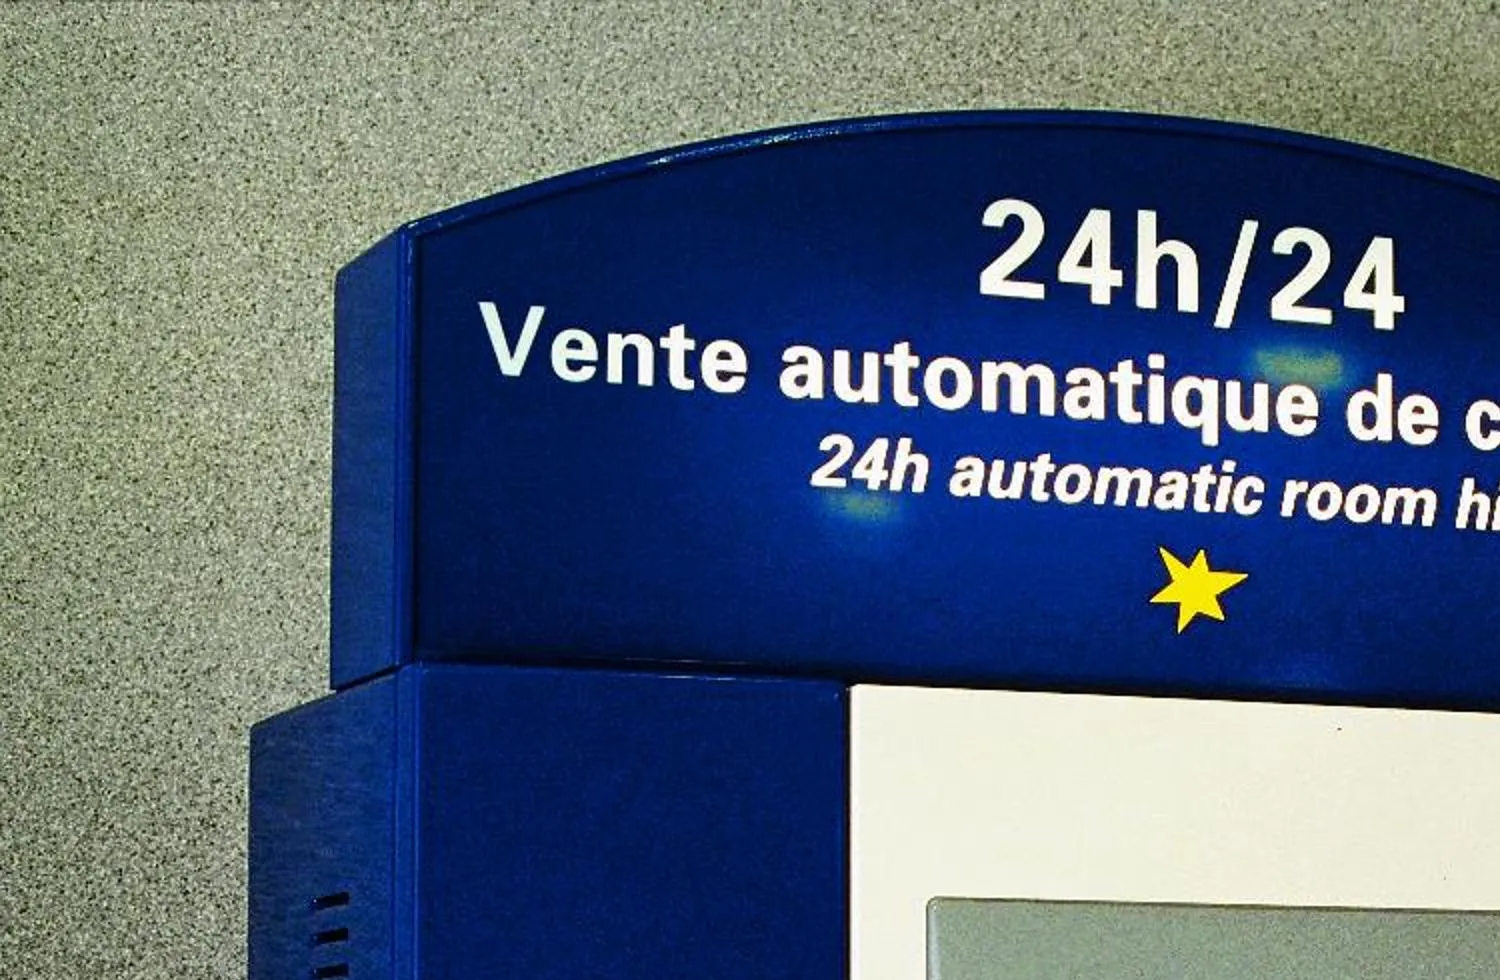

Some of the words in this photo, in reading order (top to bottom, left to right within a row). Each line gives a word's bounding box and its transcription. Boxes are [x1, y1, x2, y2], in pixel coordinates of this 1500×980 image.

[979, 199, 1405, 330] 24h/24
[479, 301, 748, 393] Vente
[779, 341, 1319, 447] automatique
[1346, 373, 1439, 445] de
[810, 433, 929, 493] 24h
[949, 453, 1265, 515] automatic
[1280, 479, 1437, 527] room
